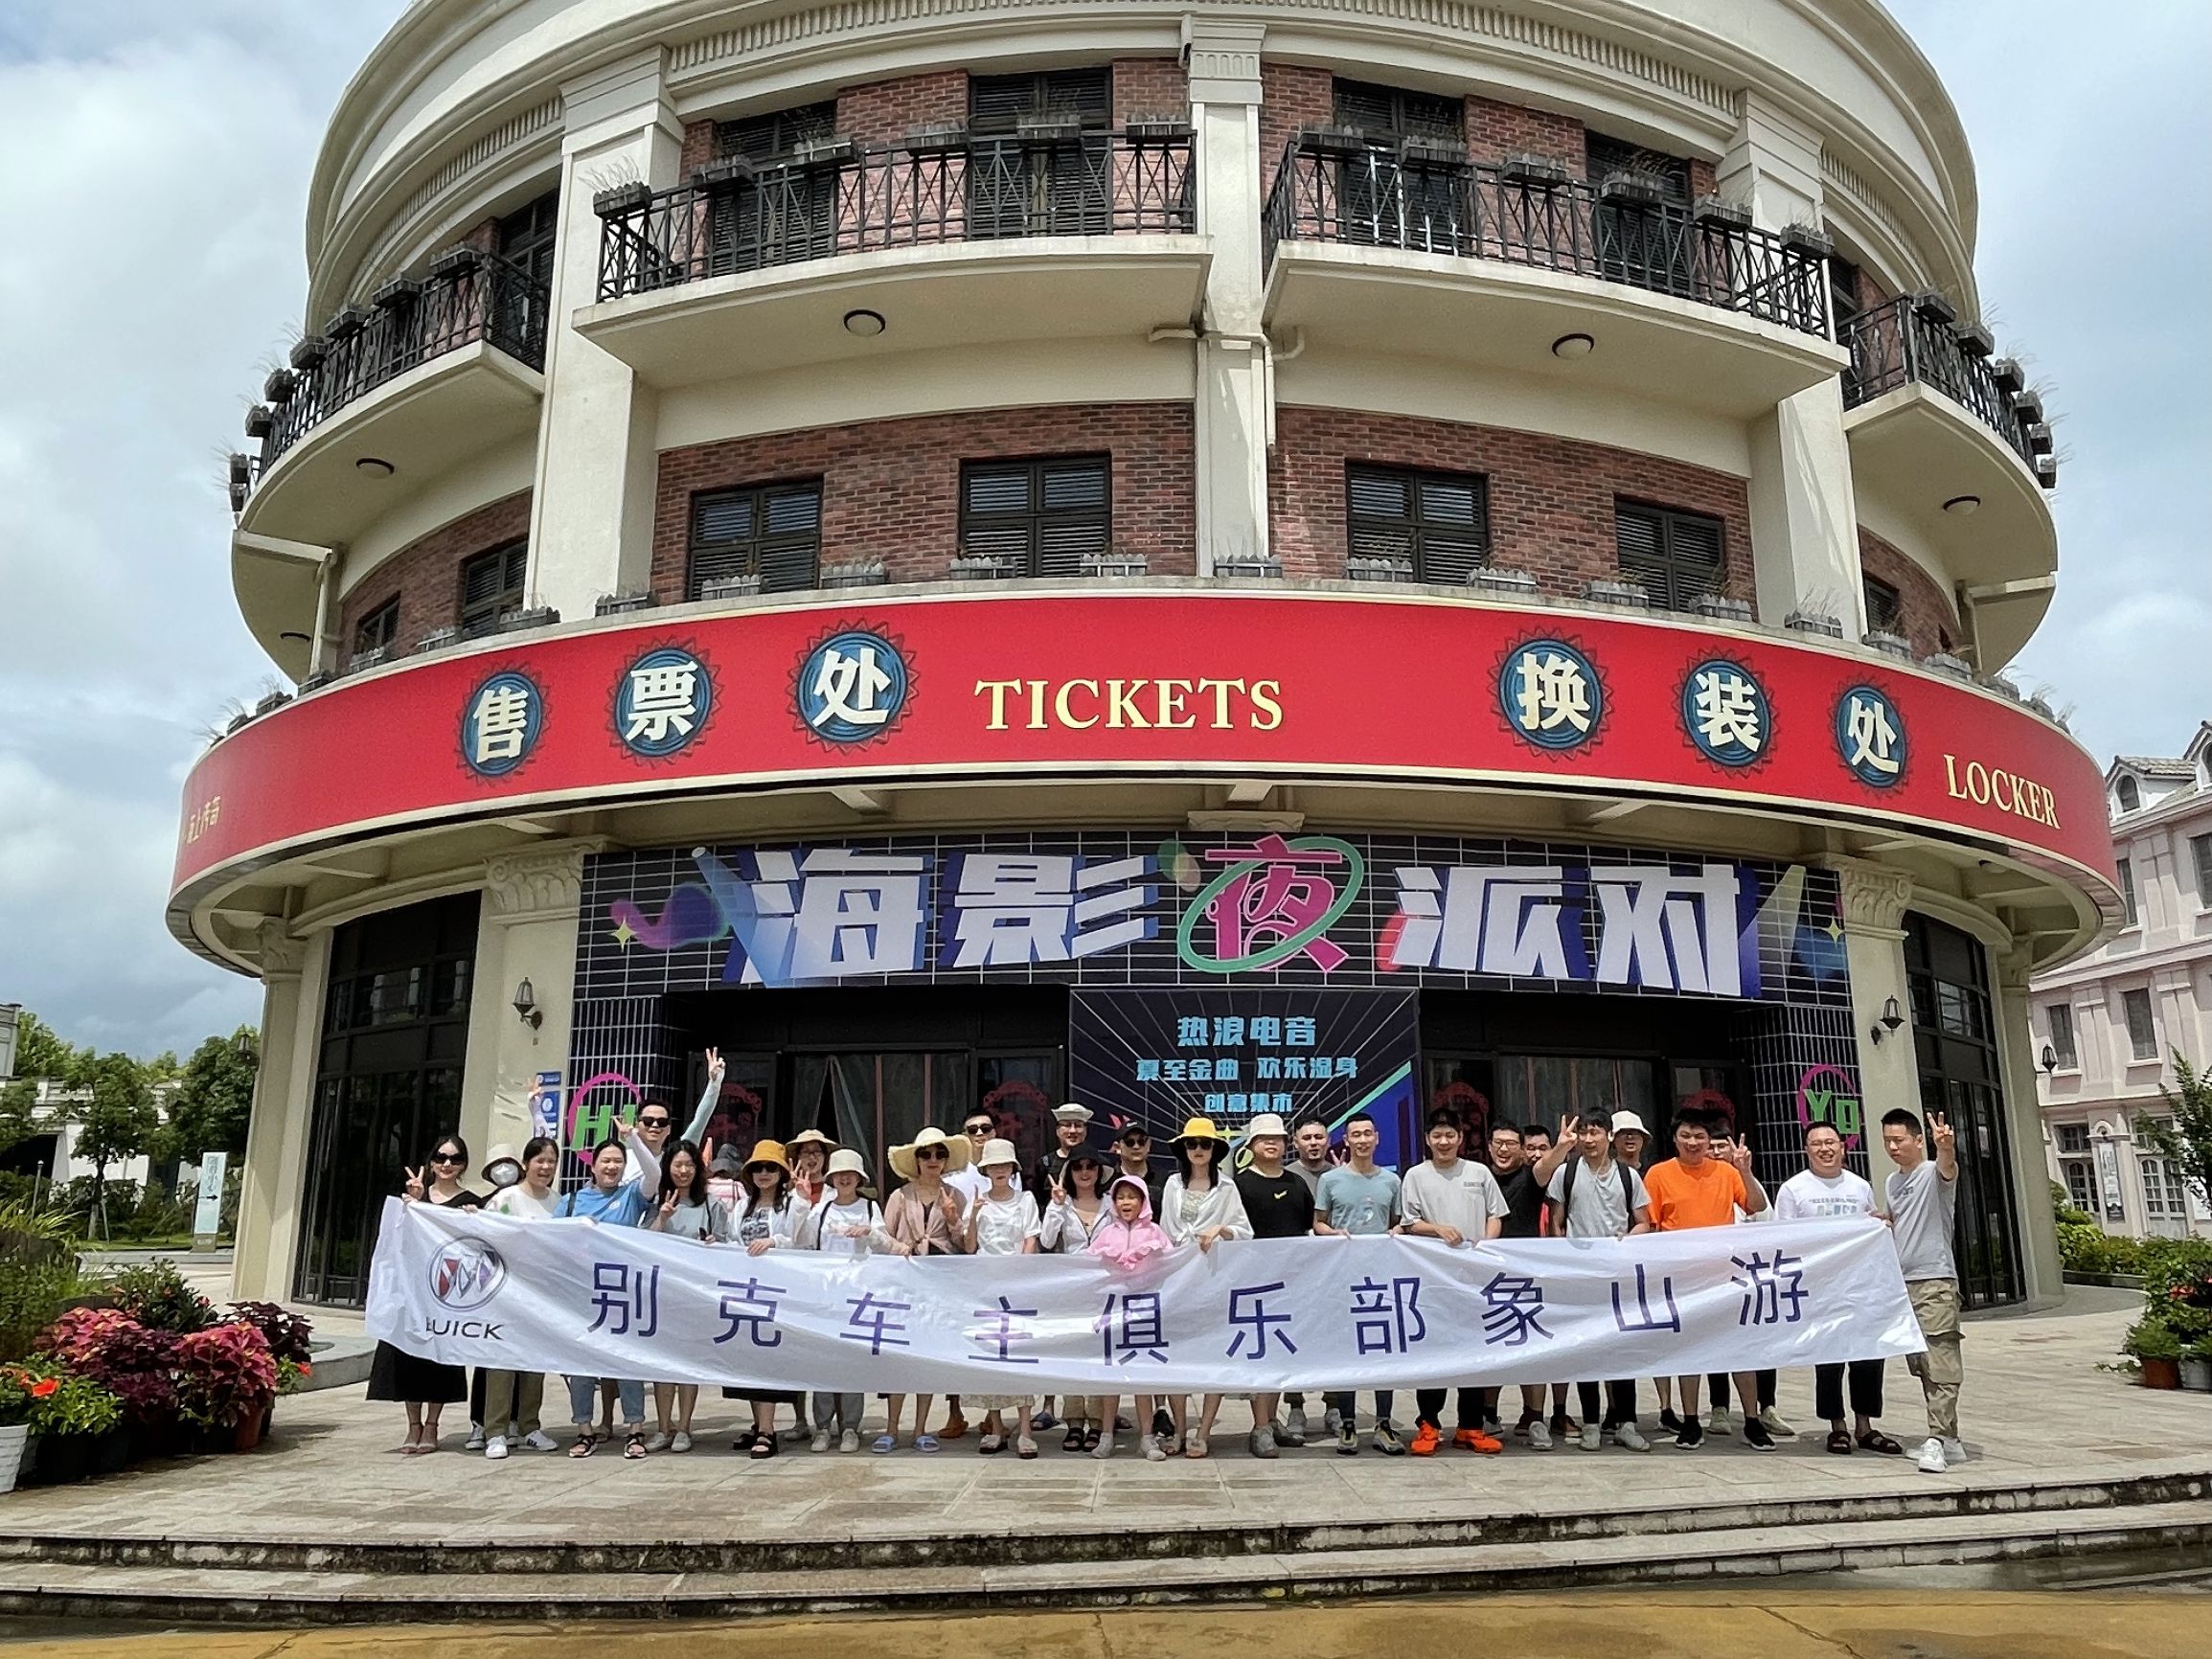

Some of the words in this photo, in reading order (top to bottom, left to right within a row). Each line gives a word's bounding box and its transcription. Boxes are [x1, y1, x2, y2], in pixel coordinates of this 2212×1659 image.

[472, 648, 892, 764] 售票处
[973, 677, 1285, 730] TICKETS
[1516, 652, 1900, 774] 换装处
[1943, 754, 2061, 830] LOCKER
[1136, 1058, 1239, 1081] 夏至金曲
[1177, 1016, 1316, 1047] 热浪电音
[587, 1248, 1810, 1366] 别克车主俱乐部象山游
